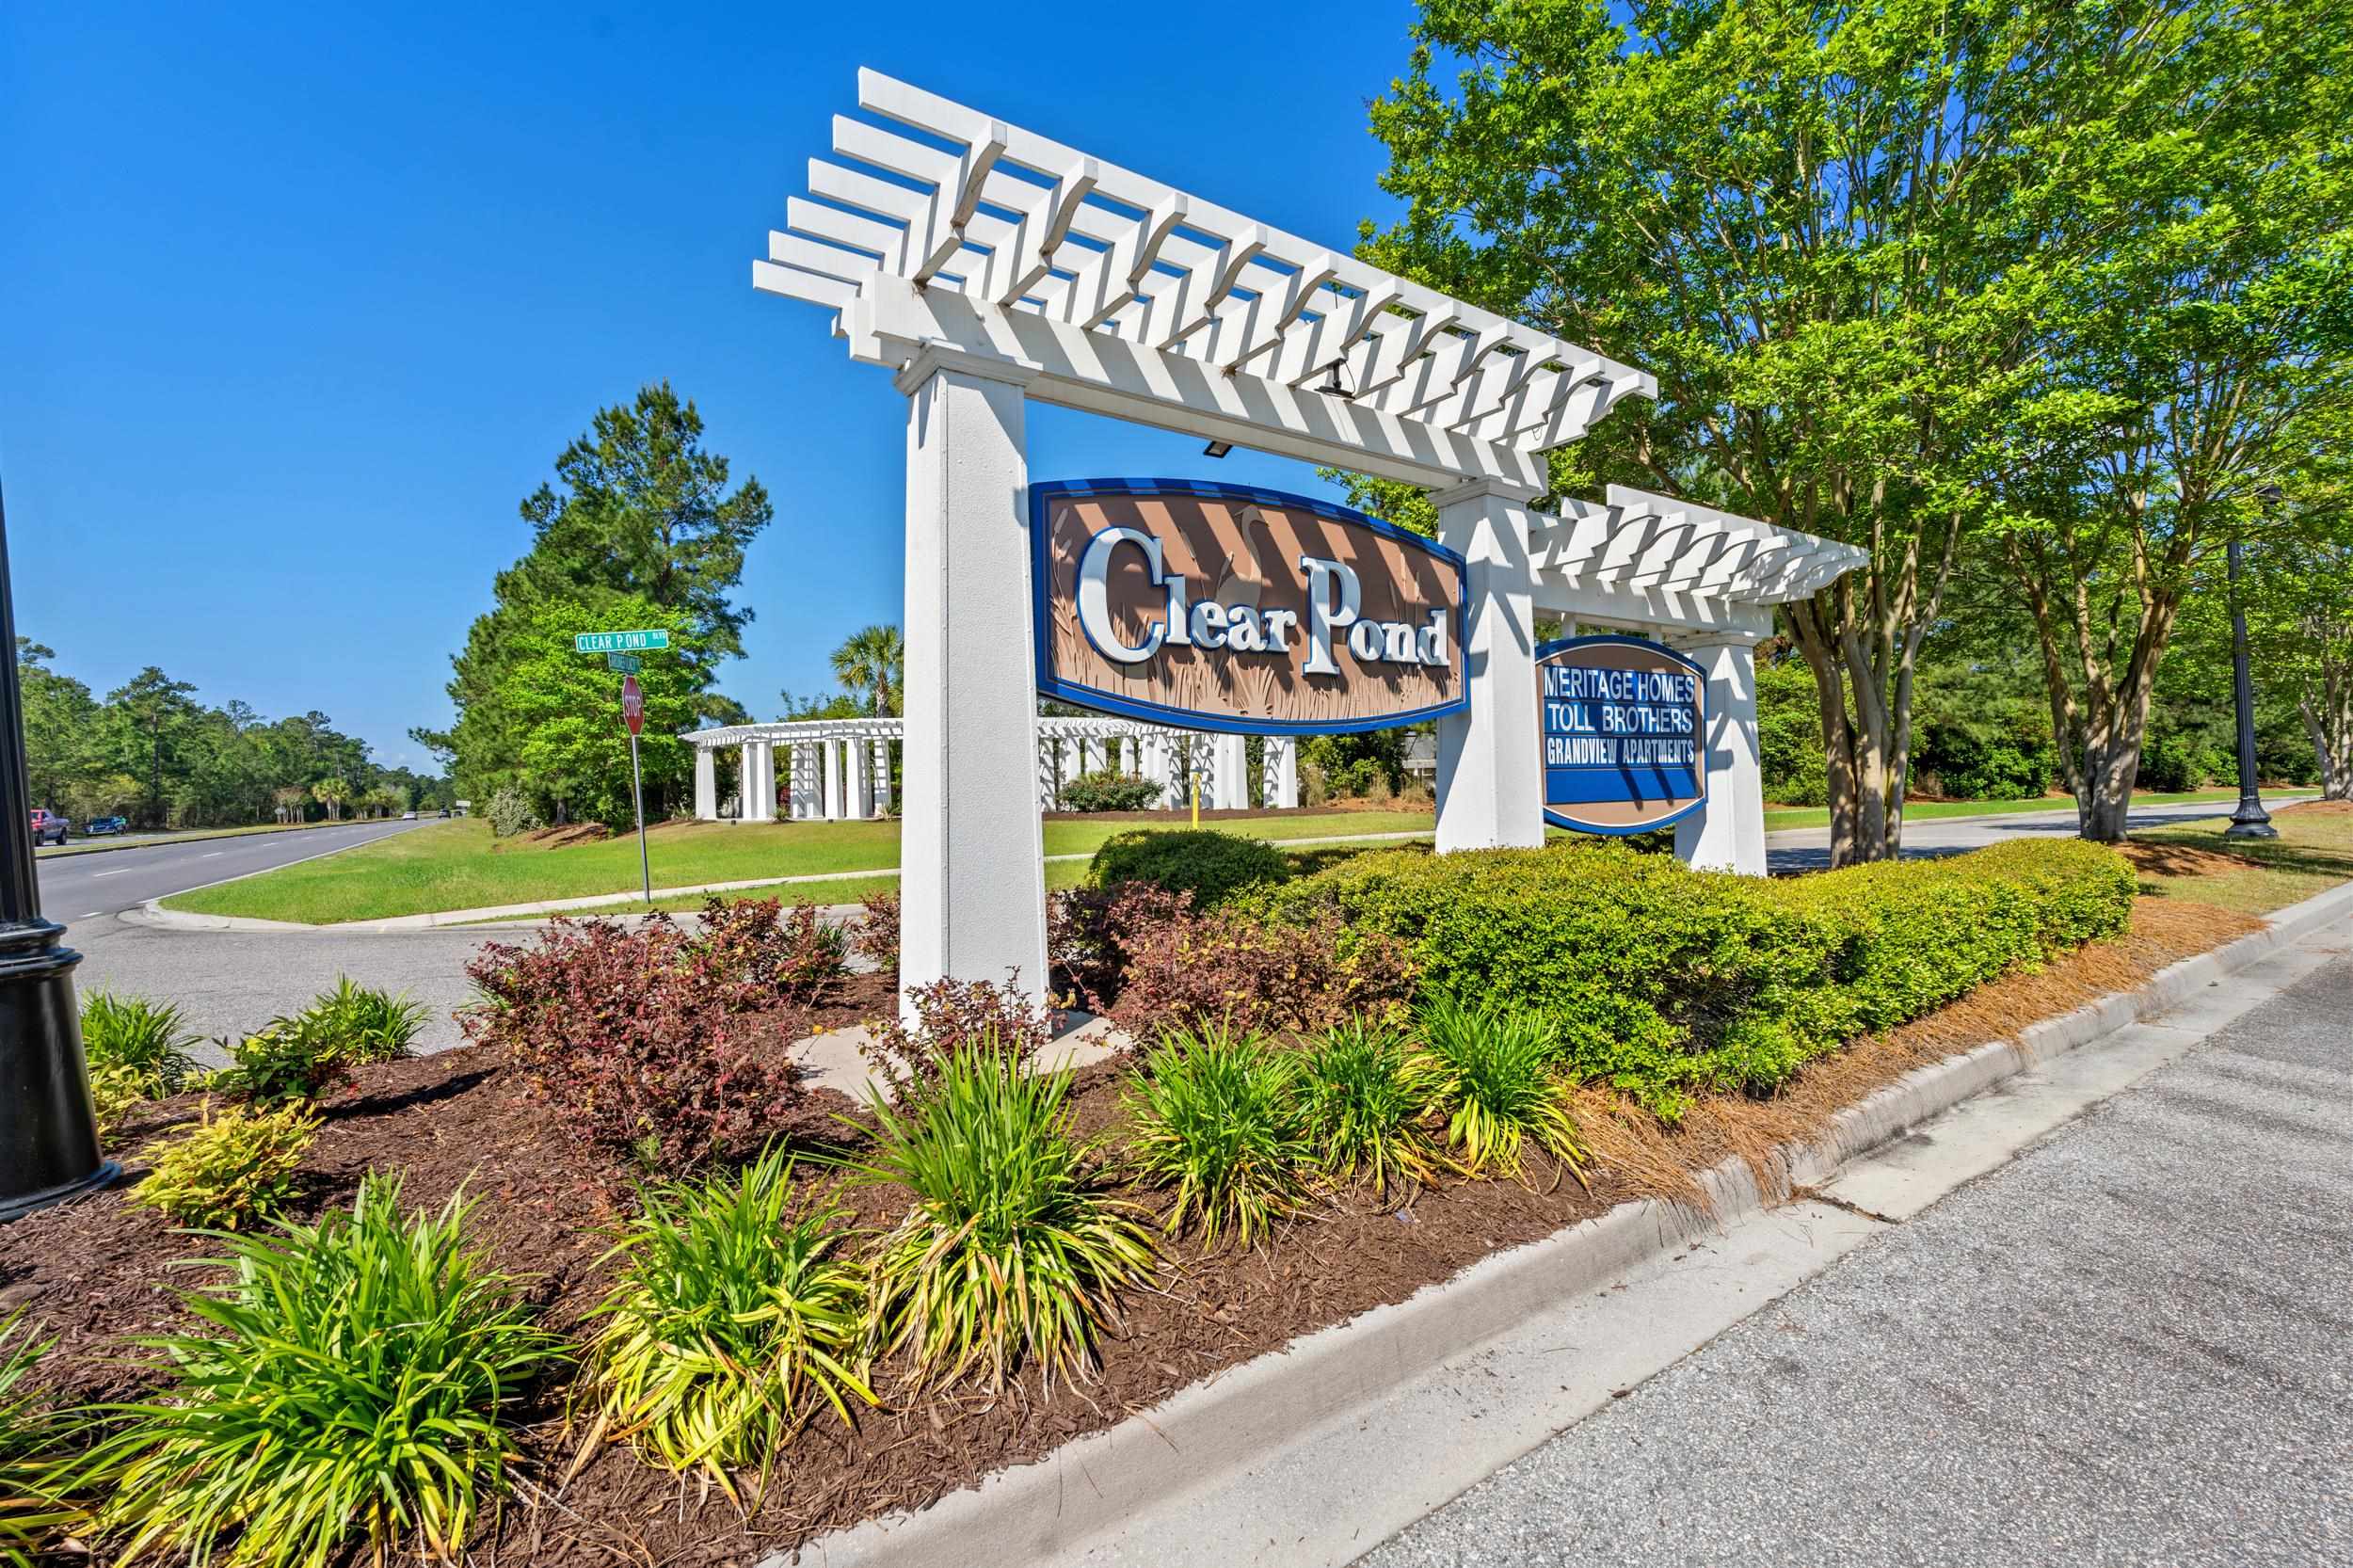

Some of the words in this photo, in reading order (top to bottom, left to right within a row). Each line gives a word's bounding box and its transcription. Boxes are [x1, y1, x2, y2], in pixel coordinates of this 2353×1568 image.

[1077, 526, 1297, 664] Clear
[1300, 554, 1450, 676] Pond
[579, 635, 612, 650] CLEAR
[616, 632, 647, 648] POND
[1544, 667, 1634, 700] MERITAGE
[1638, 673, 1695, 702] HOMES
[624, 695, 642, 716] STOP
[1548, 703, 1595, 731] TOLL
[1602, 706, 1693, 733] BROTHERS
[1547, 737, 1618, 765] GRANDVIEW
[1623, 739, 1694, 763] APARTMENTS
